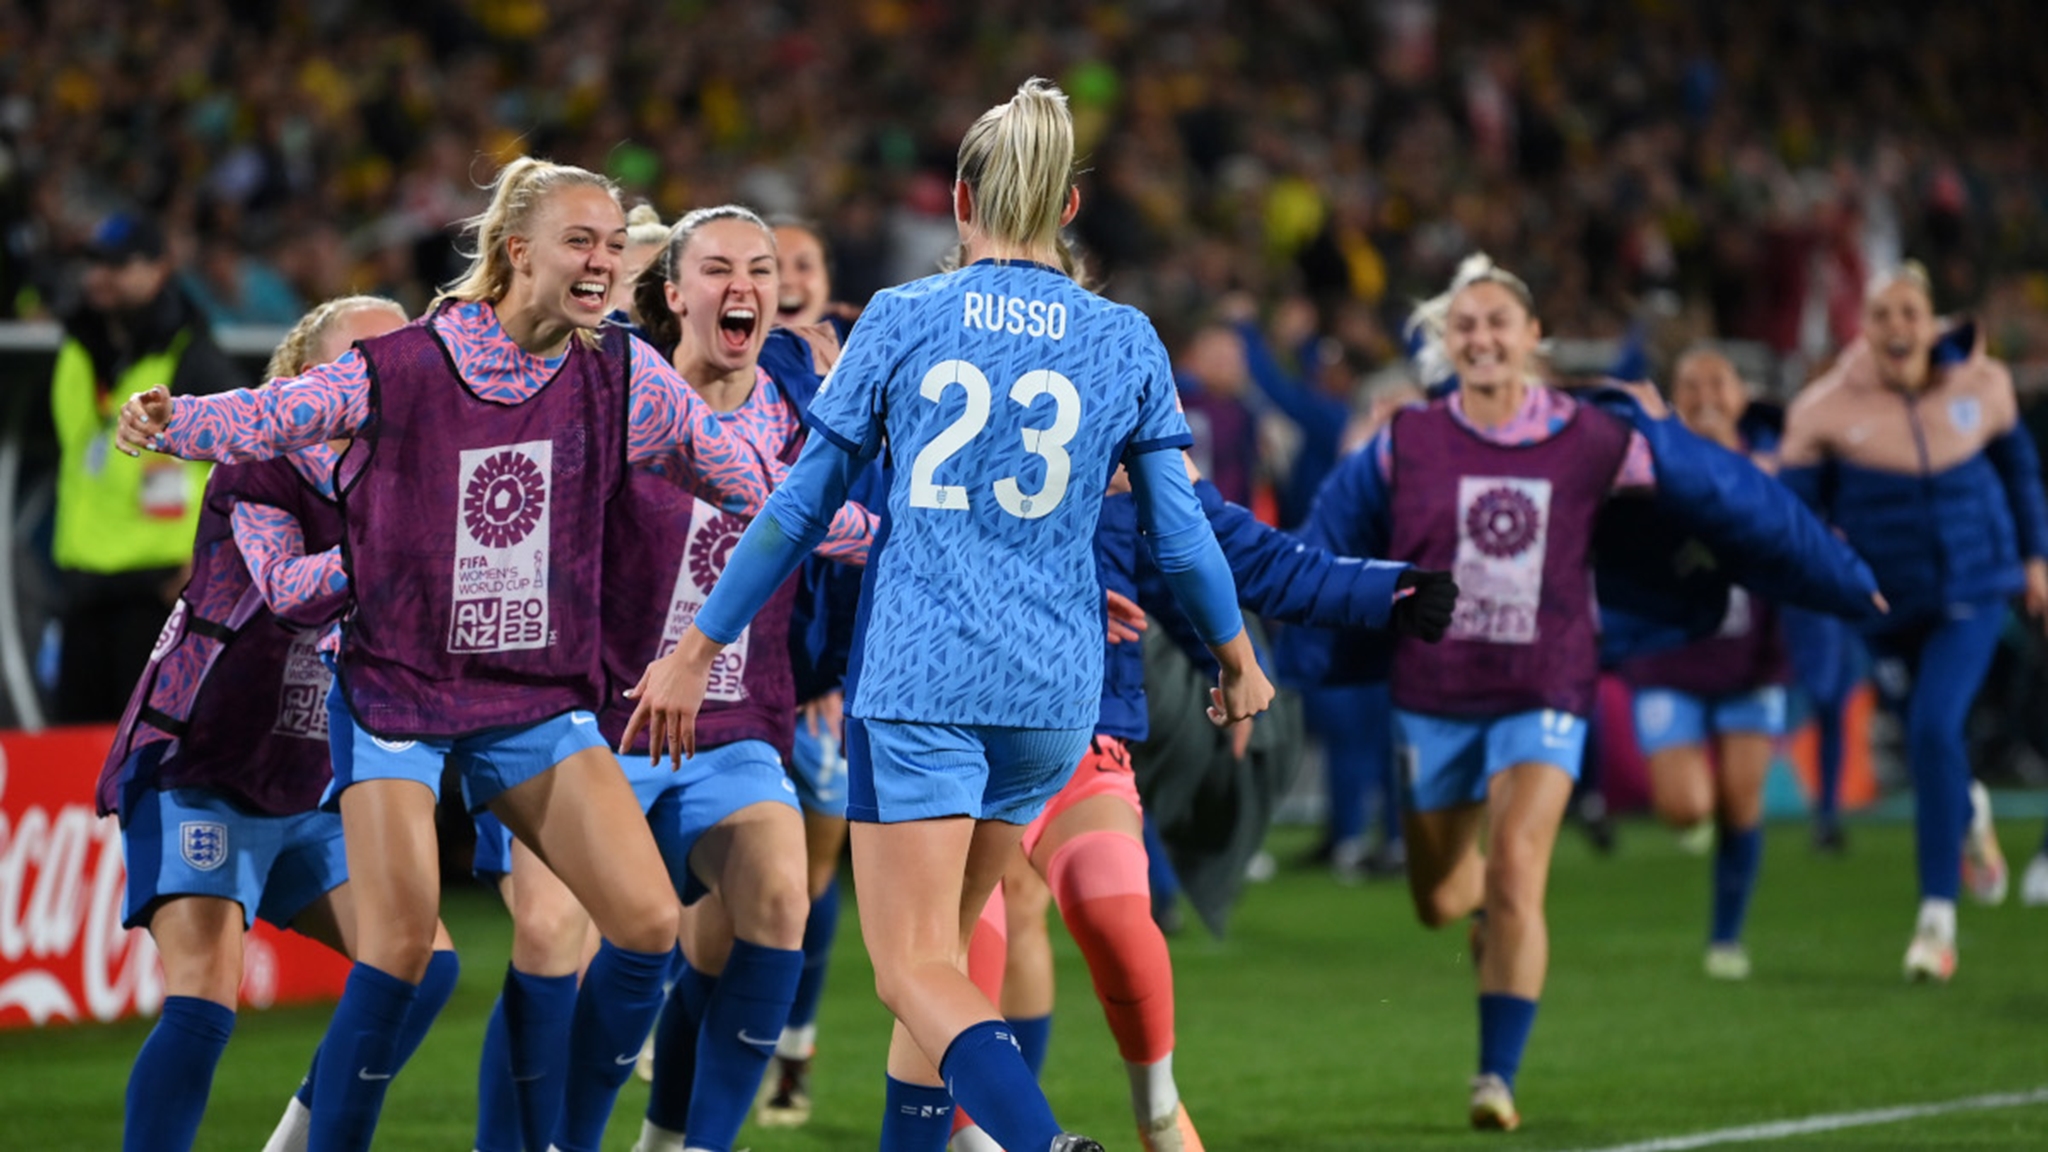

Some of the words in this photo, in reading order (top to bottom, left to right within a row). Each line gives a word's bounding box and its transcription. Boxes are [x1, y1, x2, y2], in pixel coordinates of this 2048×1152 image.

[963, 291, 1067, 341] RUSSO
[909, 359, 1081, 520] 23
[459, 556, 488, 570] FIFA
[460, 566, 519, 582] WOMEN'S
[460, 580, 504, 594] WORLD
[506, 577, 530, 591] CUP
[457, 602, 498, 626] AU
[506, 598, 543, 620] 20
[455, 624, 497, 647] NZ
[504, 621, 542, 644] 23
